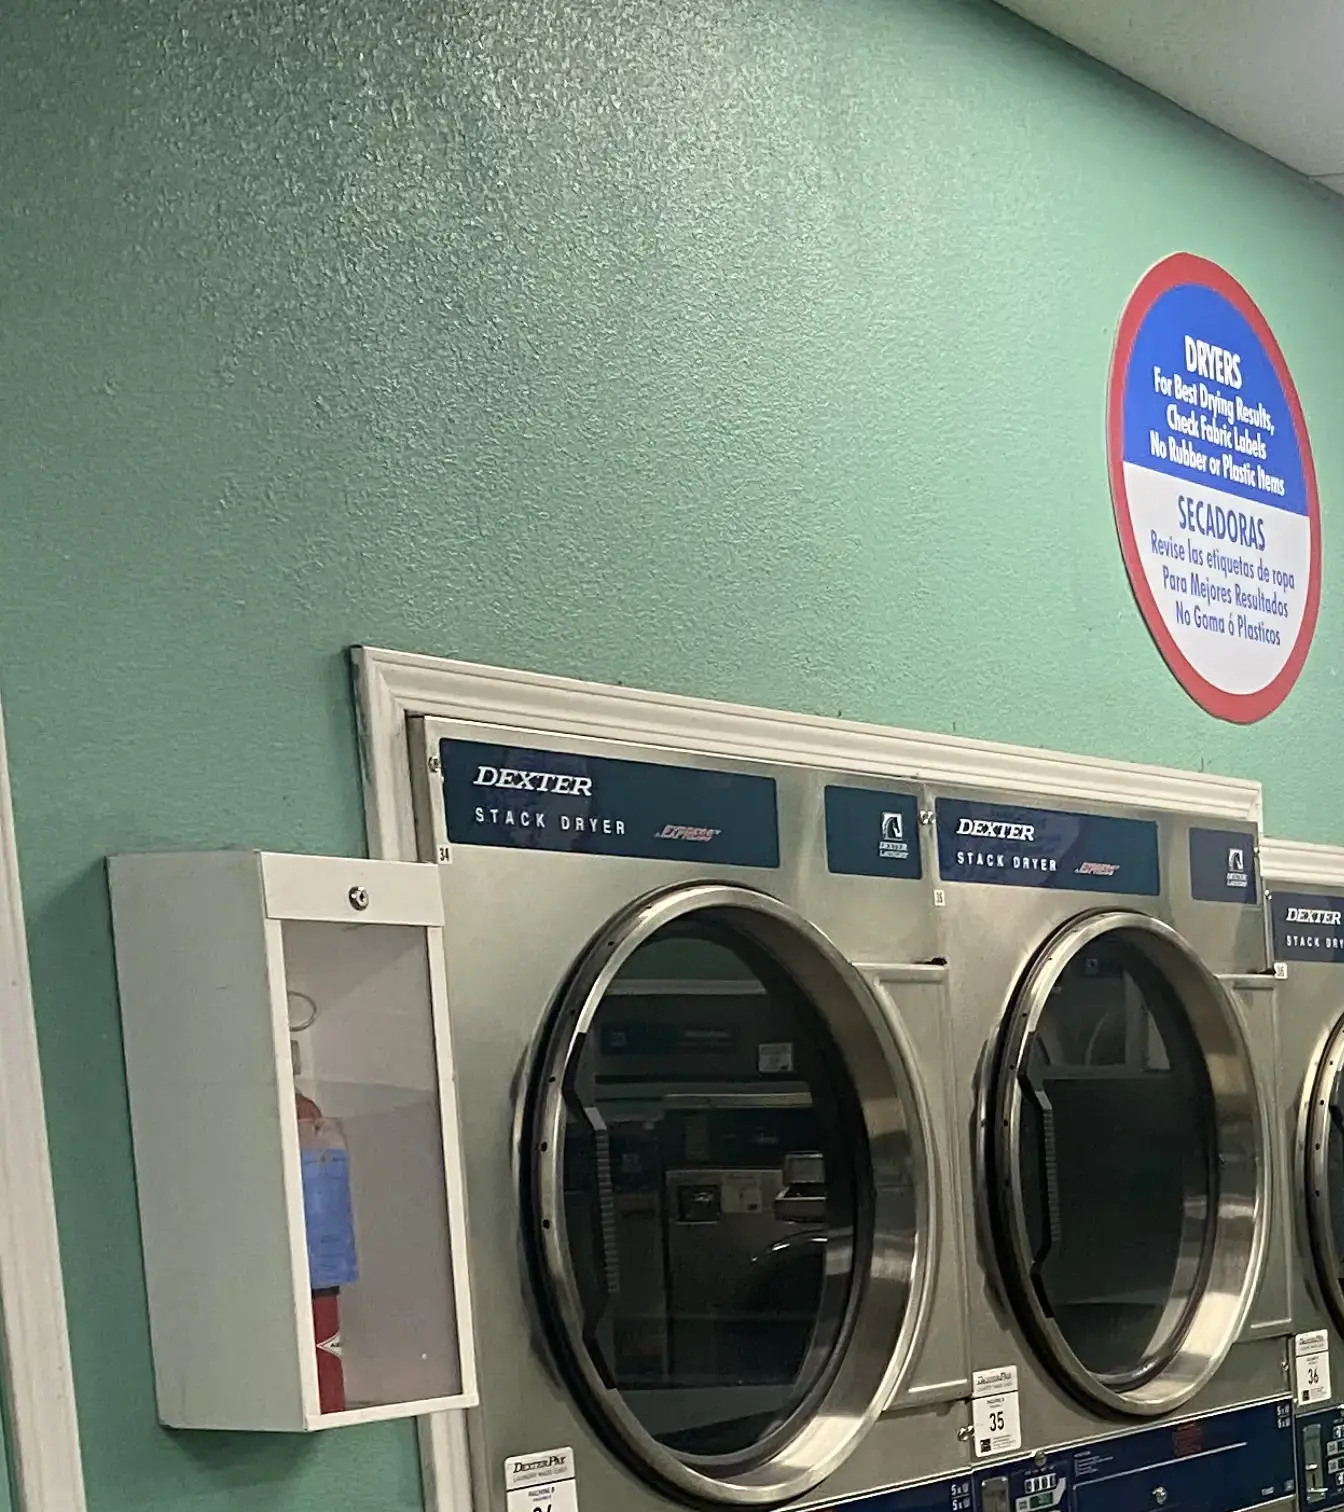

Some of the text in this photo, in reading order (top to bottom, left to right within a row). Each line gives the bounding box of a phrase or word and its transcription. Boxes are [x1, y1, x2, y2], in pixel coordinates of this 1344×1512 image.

[1185, 335, 1242, 389] DRYERS
[1154, 366, 1274, 436] For Best Drying Results,
[1167, 404, 1267, 459] Check Fabric Labels
[1150, 430, 1285, 496] No Rubber or Plastic Items
[1178, 495, 1266, 551] SECADORAS
[1150, 529, 1295, 593] Revise las etiquetas de ropa
[1162, 565, 1288, 618] Para Mejores Resultados
[1175, 600, 1190, 626] No
[1194, 605, 1225, 633] Goma
[1237, 614, 1281, 646] Plasticos
[473, 766, 592, 797] DEXTER
[475, 807, 626, 835] STACK DRYER
[957, 818, 1035, 842] DEXTER
[439, 847, 449, 861] 34
[957, 851, 1058, 872] STACK DRYER
[1286, 908, 1342, 925] DEXTER
[1286, 935, 1319, 947] STACK
[1308, 1368, 1319, 1385] 36
[989, 1411, 1004, 1431] 35
[951, 1484, 956, 1496] 5
[952, 1499, 957, 1511] 5
